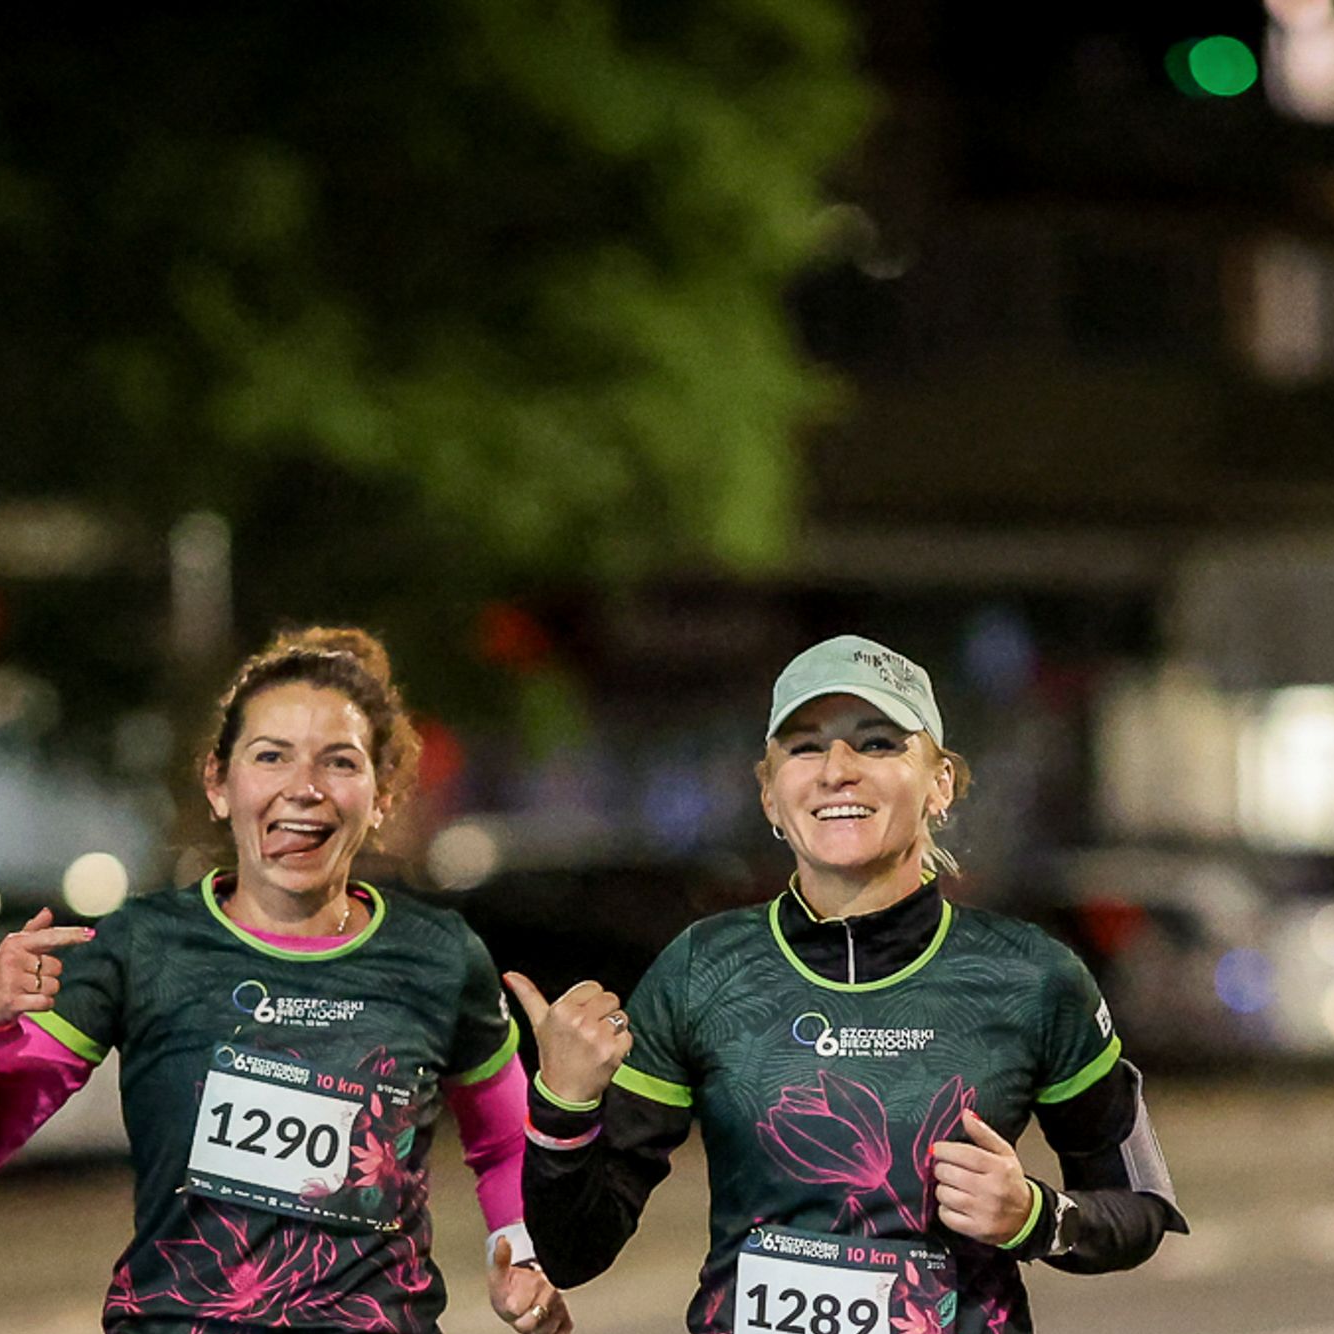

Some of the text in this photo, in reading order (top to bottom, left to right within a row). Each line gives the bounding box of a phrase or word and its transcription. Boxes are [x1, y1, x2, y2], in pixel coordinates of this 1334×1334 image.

[307, 1009, 357, 1020] NOCNY
[840, 1027, 934, 1040] SZCZECIŃSKI
[840, 1039, 926, 1050] BIEG NOCNY
[316, 1073, 334, 1090] 10
[337, 1077, 364, 1096] km
[207, 1101, 339, 1168] 1290
[847, 1247, 865, 1263] 10
[870, 1249, 898, 1265] km
